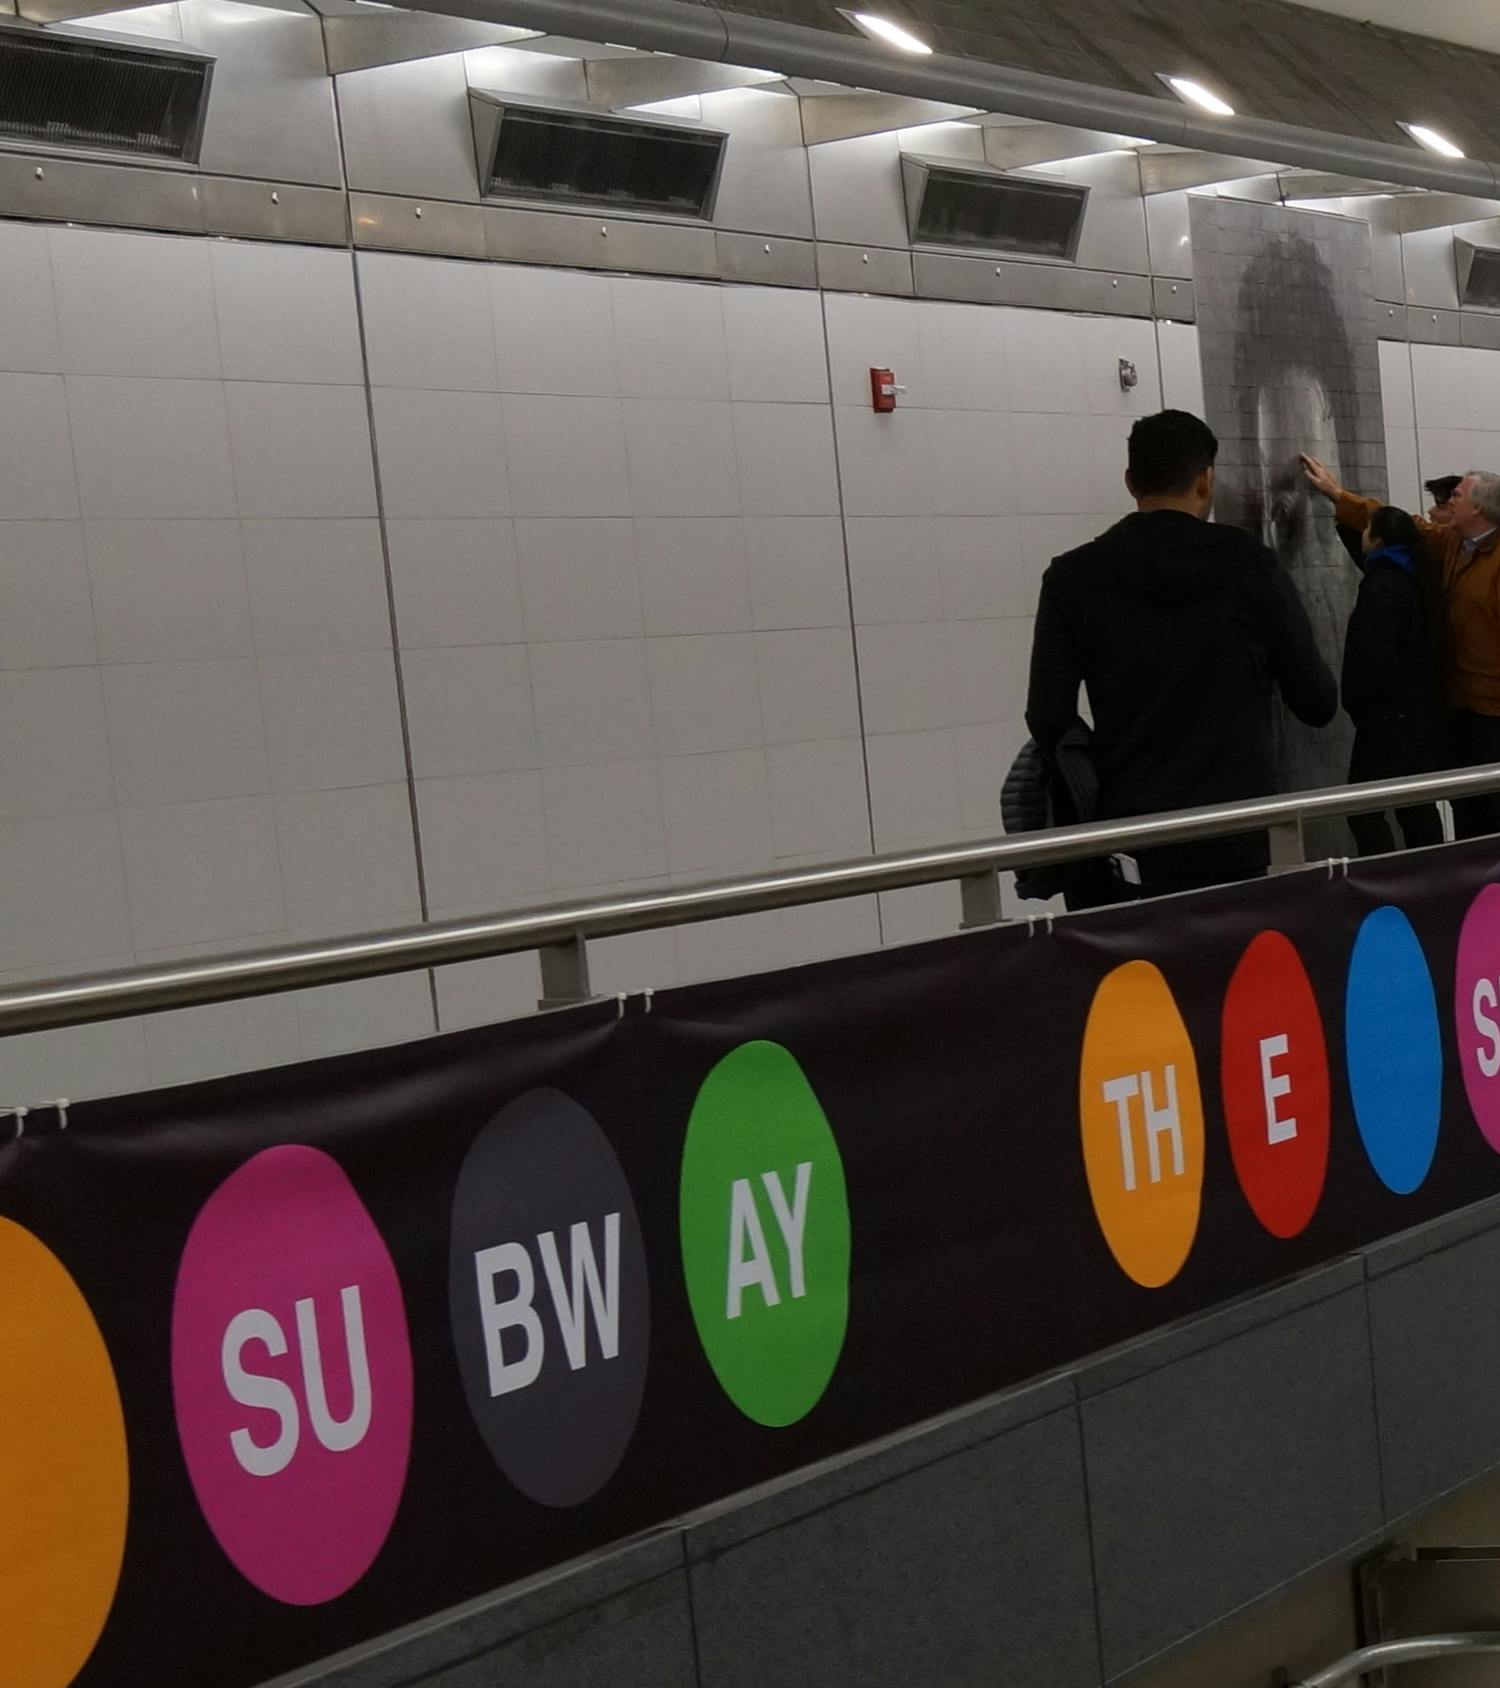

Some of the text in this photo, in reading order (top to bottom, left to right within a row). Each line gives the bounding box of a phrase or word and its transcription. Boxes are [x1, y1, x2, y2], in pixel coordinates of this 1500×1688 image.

[1102, 1063, 1185, 1192] TH
[1259, 1033, 1298, 1145] E
[220, 1161, 813, 1478] SU BW AY
